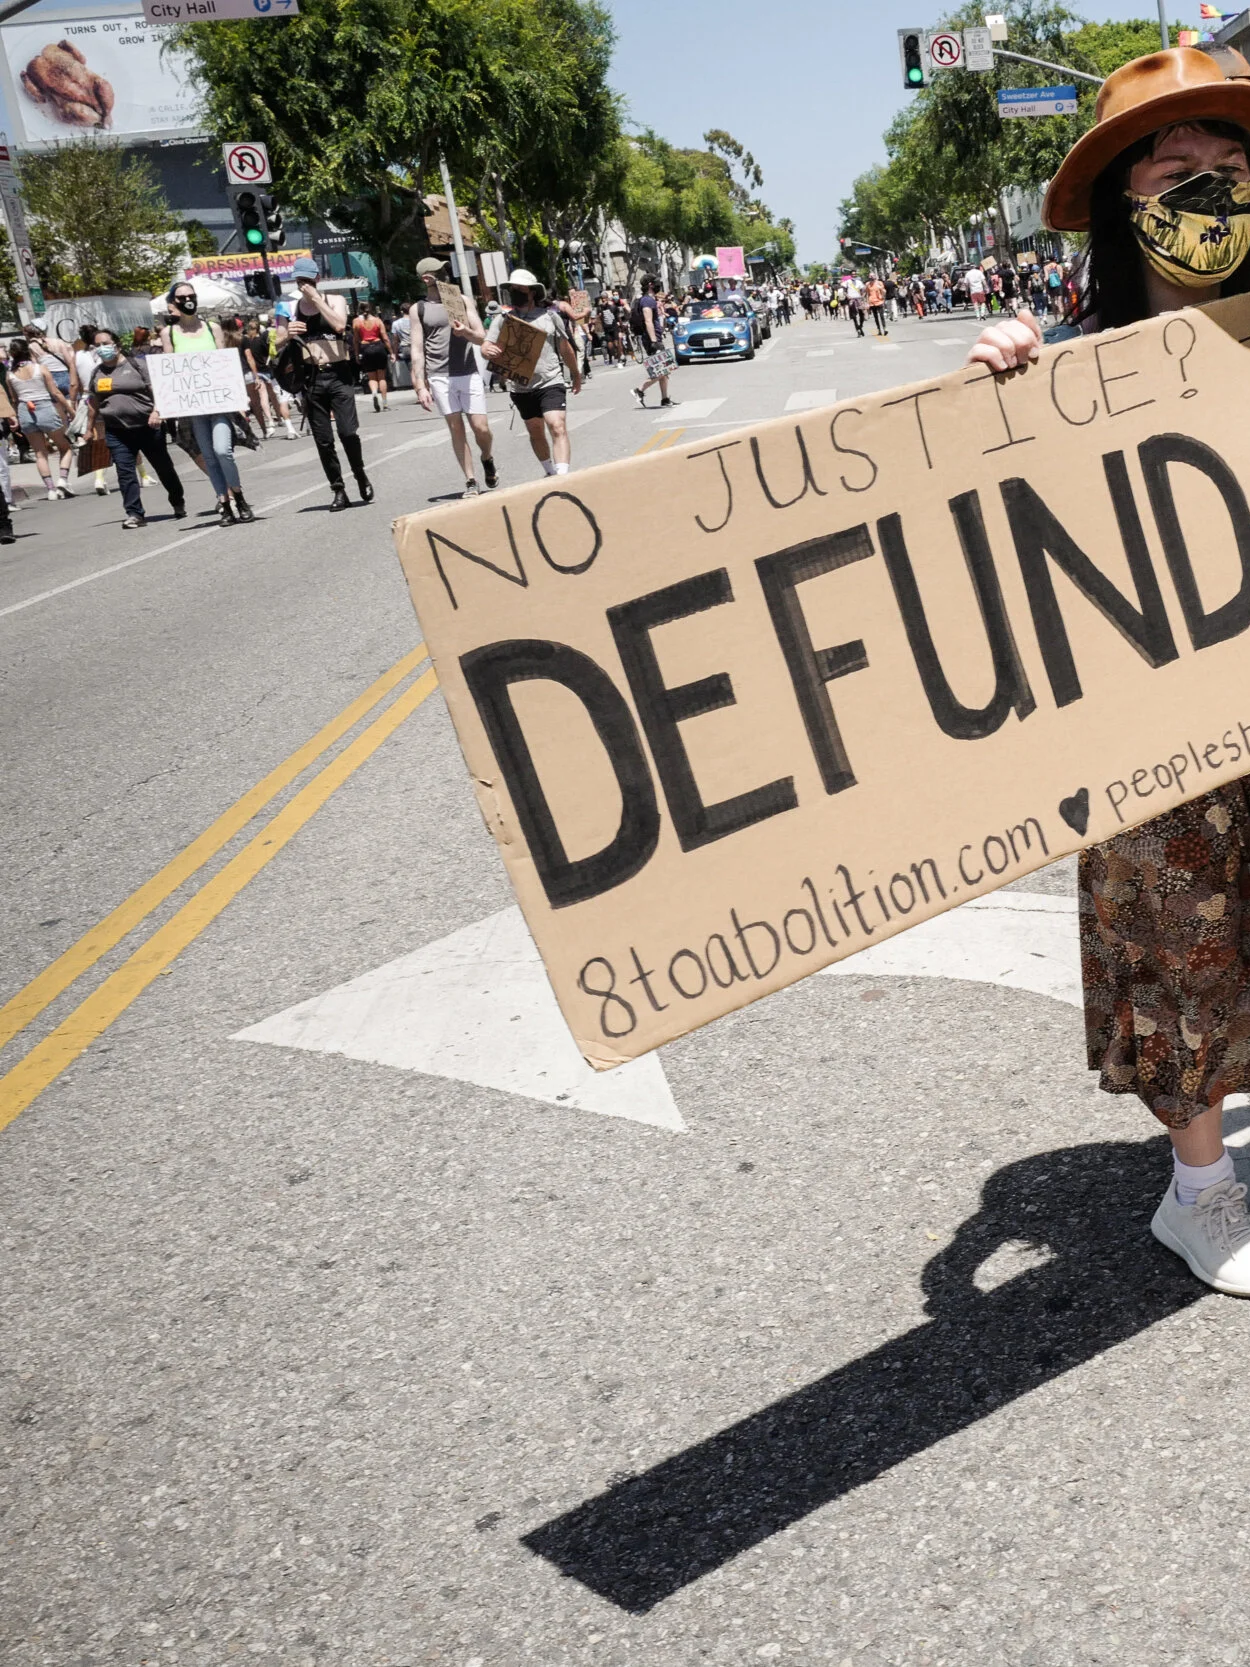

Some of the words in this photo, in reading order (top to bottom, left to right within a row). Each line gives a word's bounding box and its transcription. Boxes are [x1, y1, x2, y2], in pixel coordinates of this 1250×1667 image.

[151, 4, 181, 18] City
[187, 1, 216, 14] Hall
[64, 25, 97, 36] TURNS
[103, 23, 128, 33] OUT,
[119, 36, 145, 45] GROW
[1001, 92, 1038, 100] Sweetzer
[1040, 90, 1056, 98] Ave
[1002, 106, 1018, 114] City
[1020, 105, 1036, 113] Hall
[207, 256, 259, 271] RESIST
[161, 355, 213, 376] BLACK
[172, 373, 212, 393] LIVES
[178, 387, 235, 409] MATTER
[426, 491, 602, 610] NO
[687, 317, 1198, 534] JUSTICE?
[577, 817, 1051, 1039] 8toabolition.com
